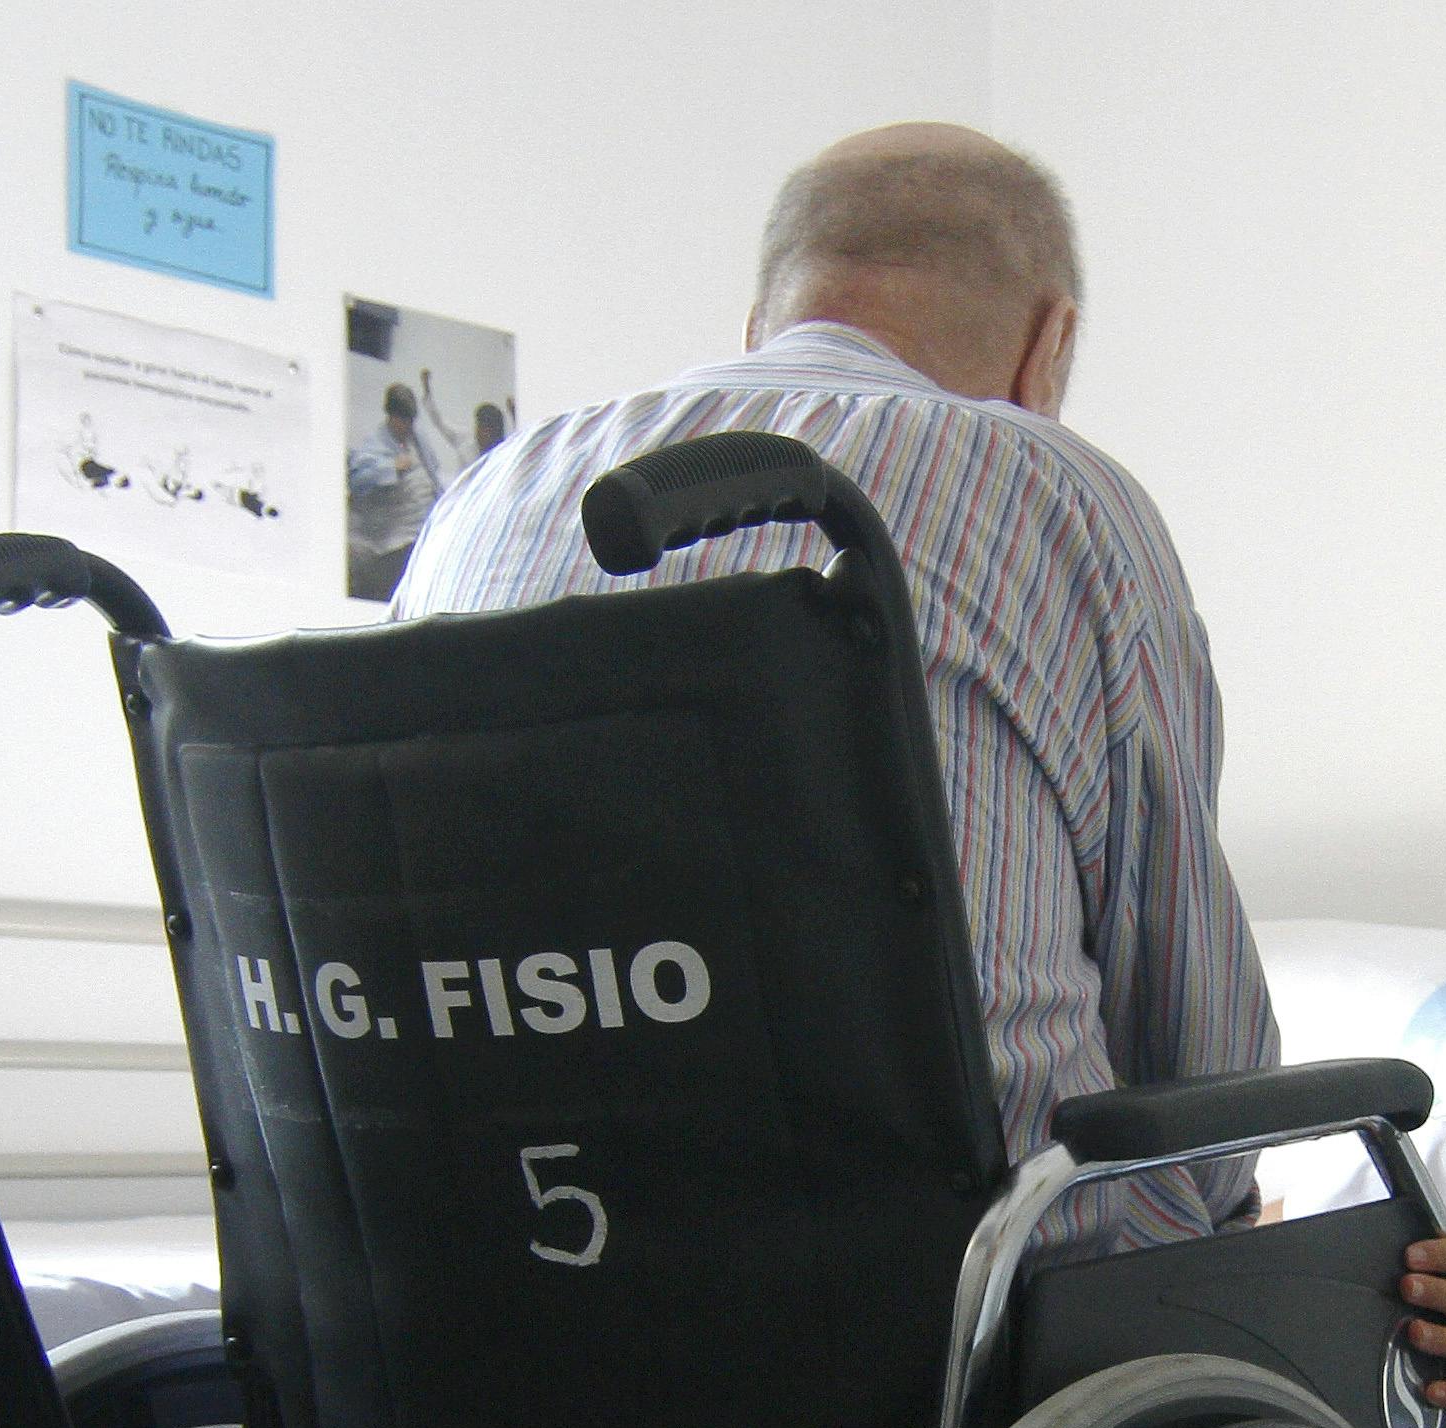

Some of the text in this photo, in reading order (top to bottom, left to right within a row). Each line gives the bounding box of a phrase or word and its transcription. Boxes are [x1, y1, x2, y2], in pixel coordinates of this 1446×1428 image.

[87, 108, 242, 170] NO TE RINDAS
[421, 941, 711, 1039] FISIO
[520, 1143, 608, 1267] 5
